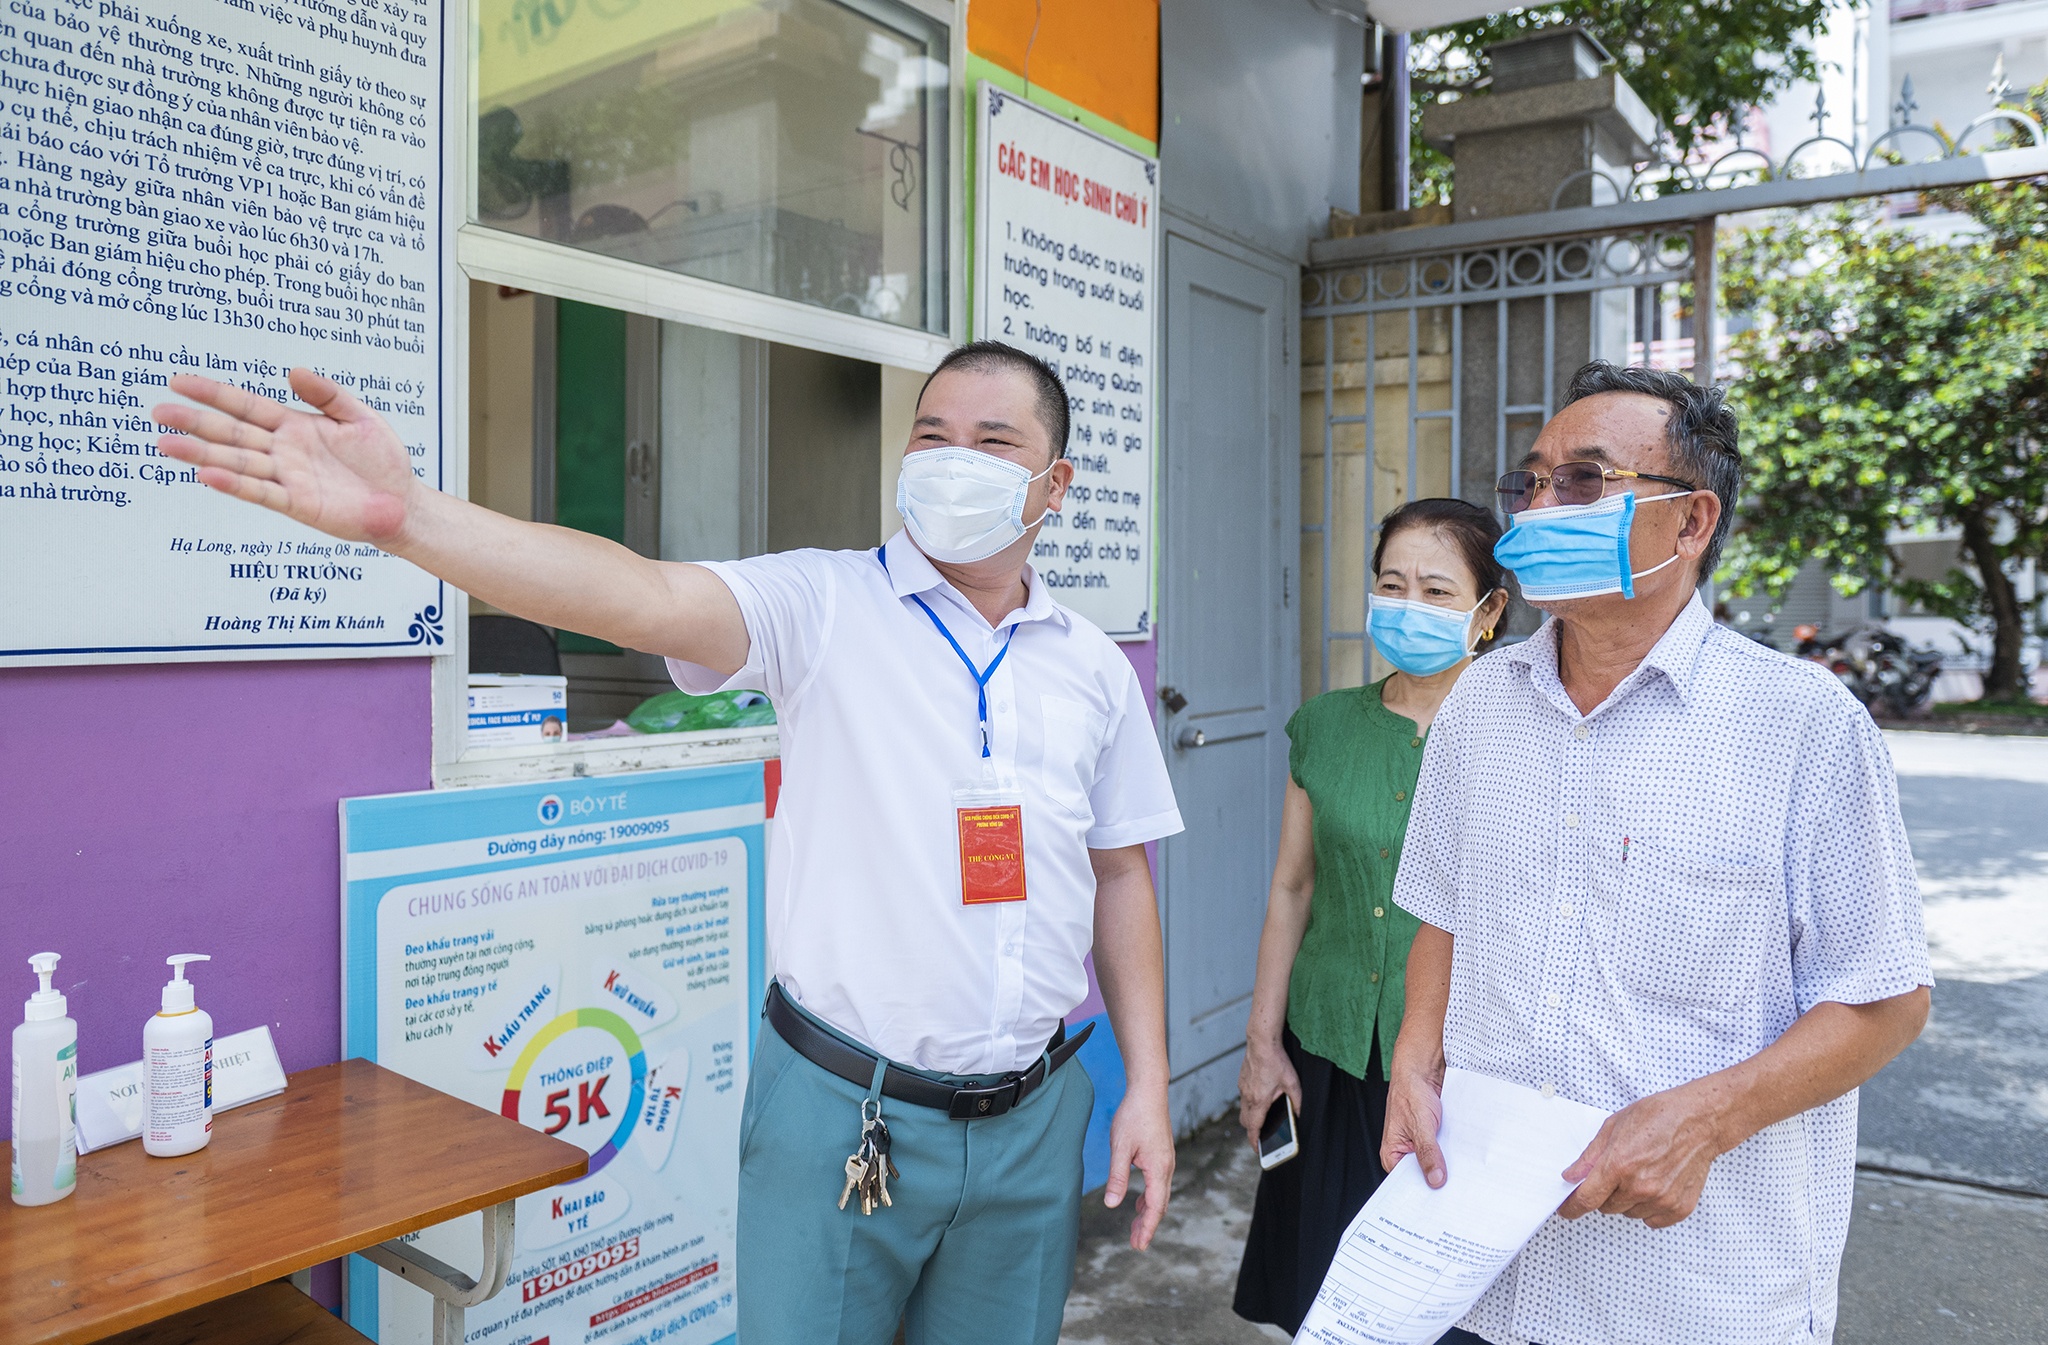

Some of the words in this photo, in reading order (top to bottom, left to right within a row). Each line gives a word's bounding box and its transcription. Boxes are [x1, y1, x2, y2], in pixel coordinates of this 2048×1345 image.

[10, 1, 45, 21] của
[54, 9, 89, 33] bảo
[98, 25, 120, 45] vệ
[128, 32, 193, 66] thường
[200, 52, 239, 75] trực.
[246, 64, 303, 97] Những
[309, 84, 353, 108] người
[360, 97, 404, 125] không
[409, 115, 426, 128] có
[100, 1, 139, 23] phải
[145, 15, 201, 45] xuống
[207, 33, 232, 52] xe,
[237, 42, 273, 63] xuất
[278, 53, 315, 75] trình
[320, 65, 352, 88] giấy
[356, 76, 371, 91] tờ
[375, 82, 406, 101] theo
[410, 93, 426, 109] sự
[998, 141, 1026, 181] CÁC
[1030, 156, 1050, 191] EM
[1054, 166, 1079, 205] HỌC
[1083, 178, 1112, 215] SINH
[1115, 191, 1138, 225] CHÚ
[1141, 196, 1148, 228] Ý
[15, 178, 52, 198] nhà
[56, 186, 122, 216] trường
[126, 197, 158, 219] bàn
[163, 207, 201, 226] giao
[205, 218, 225, 232] xe
[229, 220, 258, 238] vào
[262, 225, 286, 244] lúc
[290, 232, 328, 252] 6h30
[332, 241, 349, 257] và
[354, 245, 383, 264] 17h.
[18, 199, 67, 230] cổng
[75, 214, 140, 243] trường
[147, 228, 187, 248] giữa
[195, 234, 232, 256] buổi
[239, 243, 268, 264] học
[275, 252, 308, 271] phải
[315, 261, 333, 275] có
[339, 263, 370, 285] giấy
[377, 271, 394, 286] do
[400, 275, 425, 292] ban
[1006, 221, 1016, 242] 1.
[1021, 227, 1064, 261] Không
[1069, 244, 1101, 271] được
[1104, 259, 1117, 274] ra
[1121, 261, 1144, 283] khỏi
[1004, 253, 1048, 287] trường
[1053, 269, 1085, 298] trong
[1119, 290, 1144, 311] buổi
[1004, 316, 1015, 335] 2.
[1024, 322, 1067, 353] Trường
[1076, 335, 1093, 354] bố
[1119, 346, 1143, 368] điện
[7, 378, 46, 402] hợp
[51, 384, 94, 404] thực
[98, 387, 144, 409] hiện.
[1066, 364, 1105, 390] phòng
[1111, 373, 1142, 394] Quản
[1077, 424, 1092, 441] hệ
[1100, 429, 1116, 446] với
[1124, 435, 1141, 452] gia
[25, 452, 47, 474] sổ
[52, 458, 94, 476] theo
[99, 462, 134, 480] dõi.
[140, 464, 176, 485] Cập
[20, 482, 57, 500] nhà
[61, 484, 132, 507] trường.
[1096, 486, 1118, 503] cha
[1123, 490, 1141, 507] mẹ
[1072, 510, 1096, 530] đến
[1105, 515, 1140, 534] muộn,
[170, 538, 193, 555] Hạ
[196, 539, 236, 555] Long,
[241, 543, 272, 556] ngày
[277, 541, 292, 554] 15
[297, 543, 331, 558] tháng
[335, 543, 350, 556] 08
[354, 545, 379, 557] năm
[1034, 542, 1058, 557] sinh
[1126, 546, 1140, 562] tại
[229, 561, 278, 582] HIỆU
[284, 562, 363, 581] TRƯỞNG
[1047, 570, 1082, 588] Quản
[1084, 571, 1110, 588] sinh.
[269, 586, 299, 604] (Đã
[304, 587, 327, 604] ký)
[204, 615, 262, 633] Hoàng
[268, 615, 294, 633] Thị
[299, 616, 331, 630] Kim
[335, 616, 385, 630] Khánh
[569, 796, 594, 817] BỘ
[487, 840, 537, 856] Đường
[540, 834, 566, 850] dây
[568, 830, 606, 845] nóng:
[609, 819, 670, 840] 19009095
[408, 890, 466, 918] CHUNG
[471, 881, 513, 908] SỐNG
[517, 879, 539, 899] AN
[542, 871, 580, 894] TOÀN
[584, 867, 609, 887] VỚI
[611, 863, 639, 885] ĐẠI
[639, 856, 668, 878] DỊCH
[671, 849, 728, 874] COVID-19
[483, 1019, 521, 1058] KHẨU
[519, 984, 552, 1022] TRANG
[540, 1064, 584, 1087] THÔNG
[586, 1056, 614, 1074] ĐIỆP
[110, 1083, 139, 1101] NƠI
[543, 1073, 611, 1135] 5K
[656, 1085, 682, 1132] KHÔNG
[552, 1196, 582, 1220] KHAI
[585, 1191, 606, 1208] BÁO
[568, 1221, 576, 1233] Y
[576, 1213, 589, 1229] TẾ
[525, 1239, 638, 1299] 19009095
